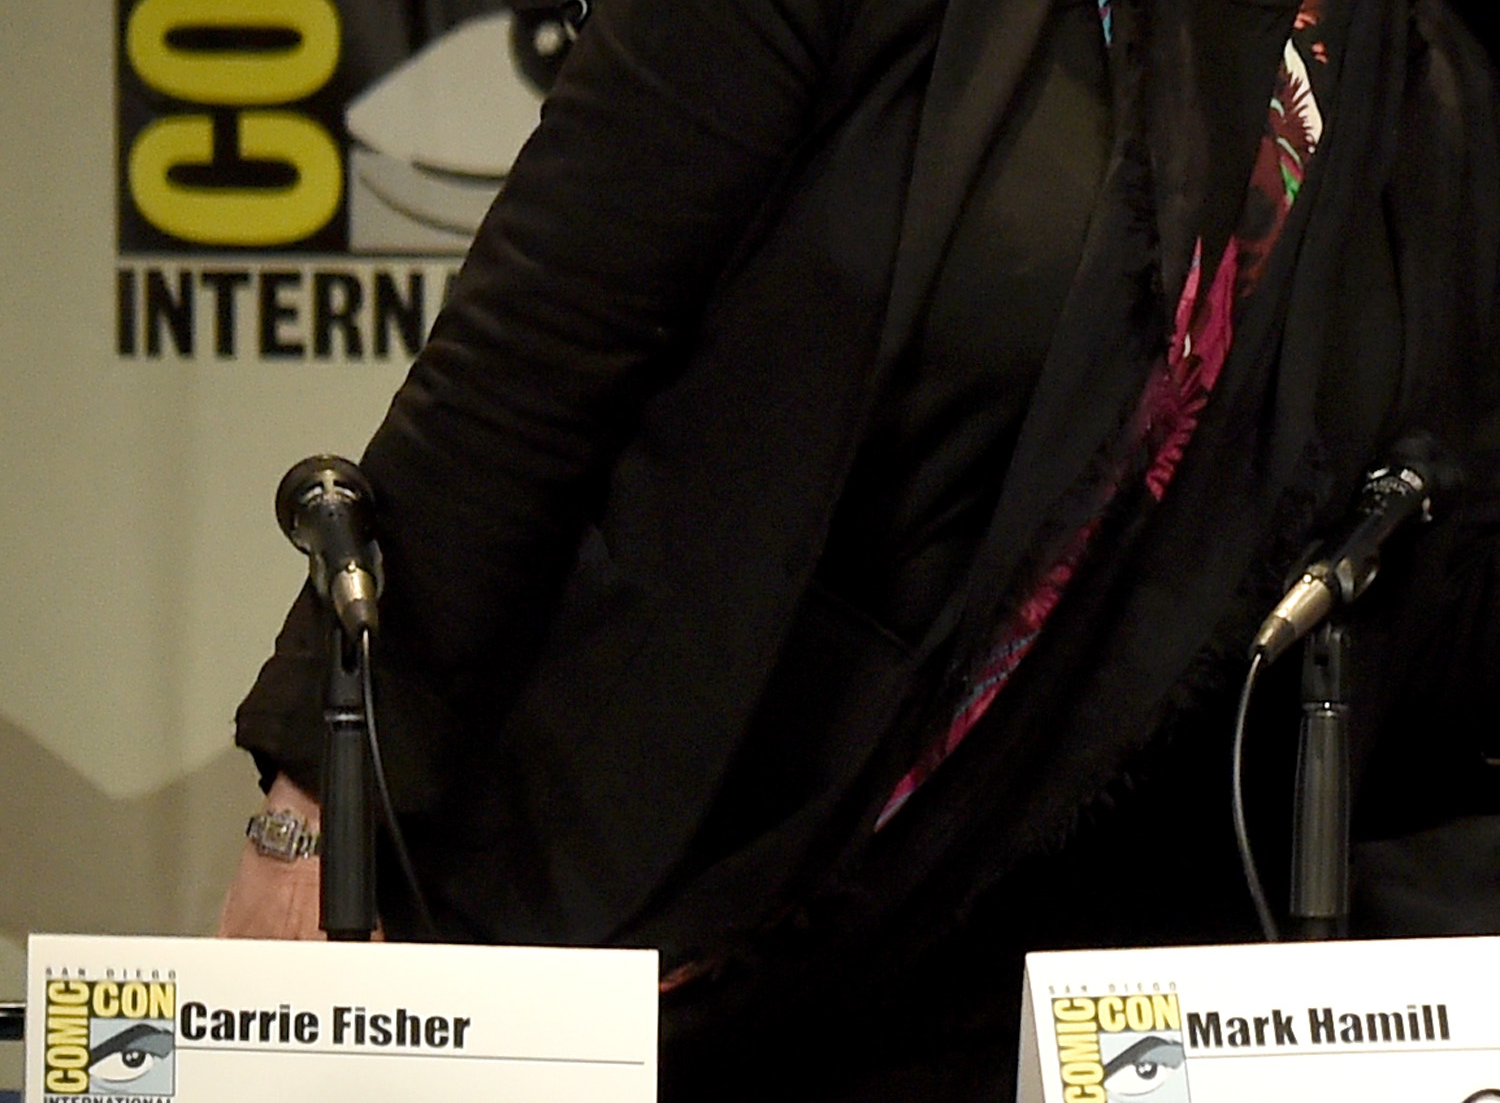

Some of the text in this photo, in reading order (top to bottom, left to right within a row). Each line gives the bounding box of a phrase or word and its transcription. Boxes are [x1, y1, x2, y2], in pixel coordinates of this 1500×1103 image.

[117, 267, 463, 359] INTERN
[92, 981, 175, 1019] CON
[1097, 994, 1182, 1033] CON
[46, 981, 90, 1093] COMIC
[180, 1001, 470, 1049] Carrie Fisher
[1186, 1004, 1450, 1049] Mark Hamill
